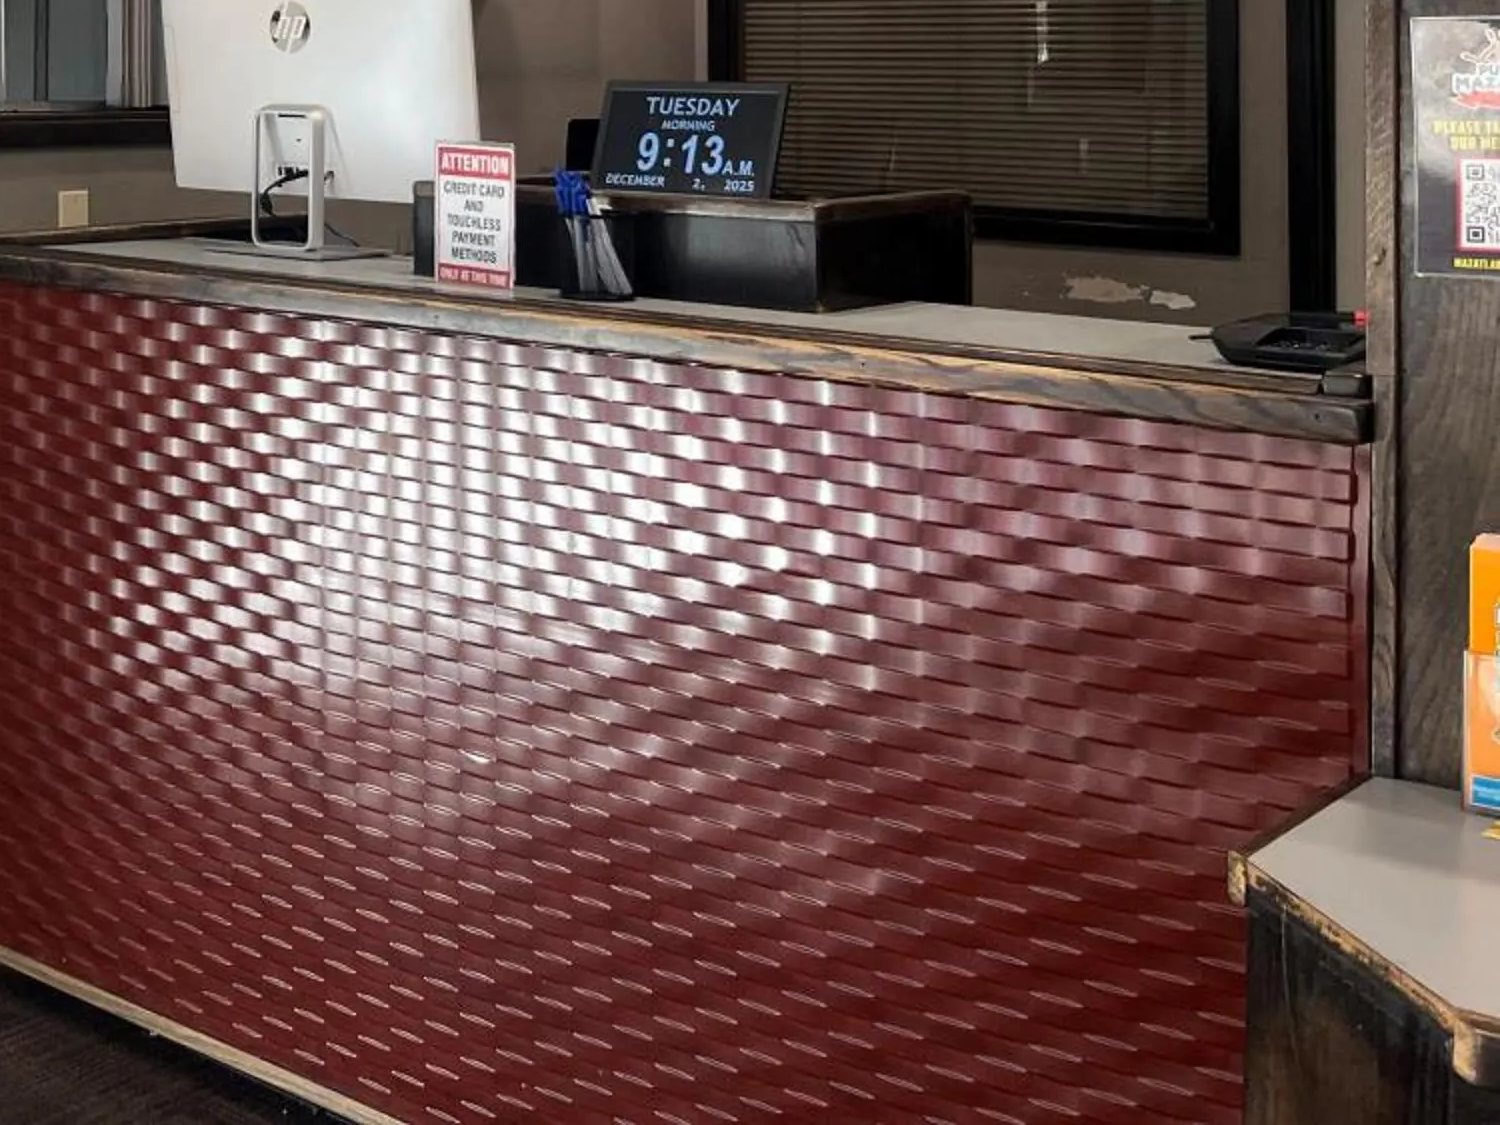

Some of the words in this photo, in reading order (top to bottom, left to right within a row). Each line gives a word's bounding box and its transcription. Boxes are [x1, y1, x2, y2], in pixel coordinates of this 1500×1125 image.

[646, 96, 740, 116] TUESDAY
[661, 119, 715, 132] MORNING
[441, 152, 509, 175] ATTENTION
[636, 132, 724, 175] 9:13
[721, 160, 755, 177] A.M.
[443, 181, 476, 195] CREDIT
[479, 184, 505, 198] CARD
[605, 173, 665, 188] DECEMBER
[724, 180, 755, 192] 2025
[463, 199, 484, 213] AND
[447, 213, 501, 232] TOUCHLESS
[451, 230, 496, 247] PAYMENT
[451, 246, 497, 264] METHODS
